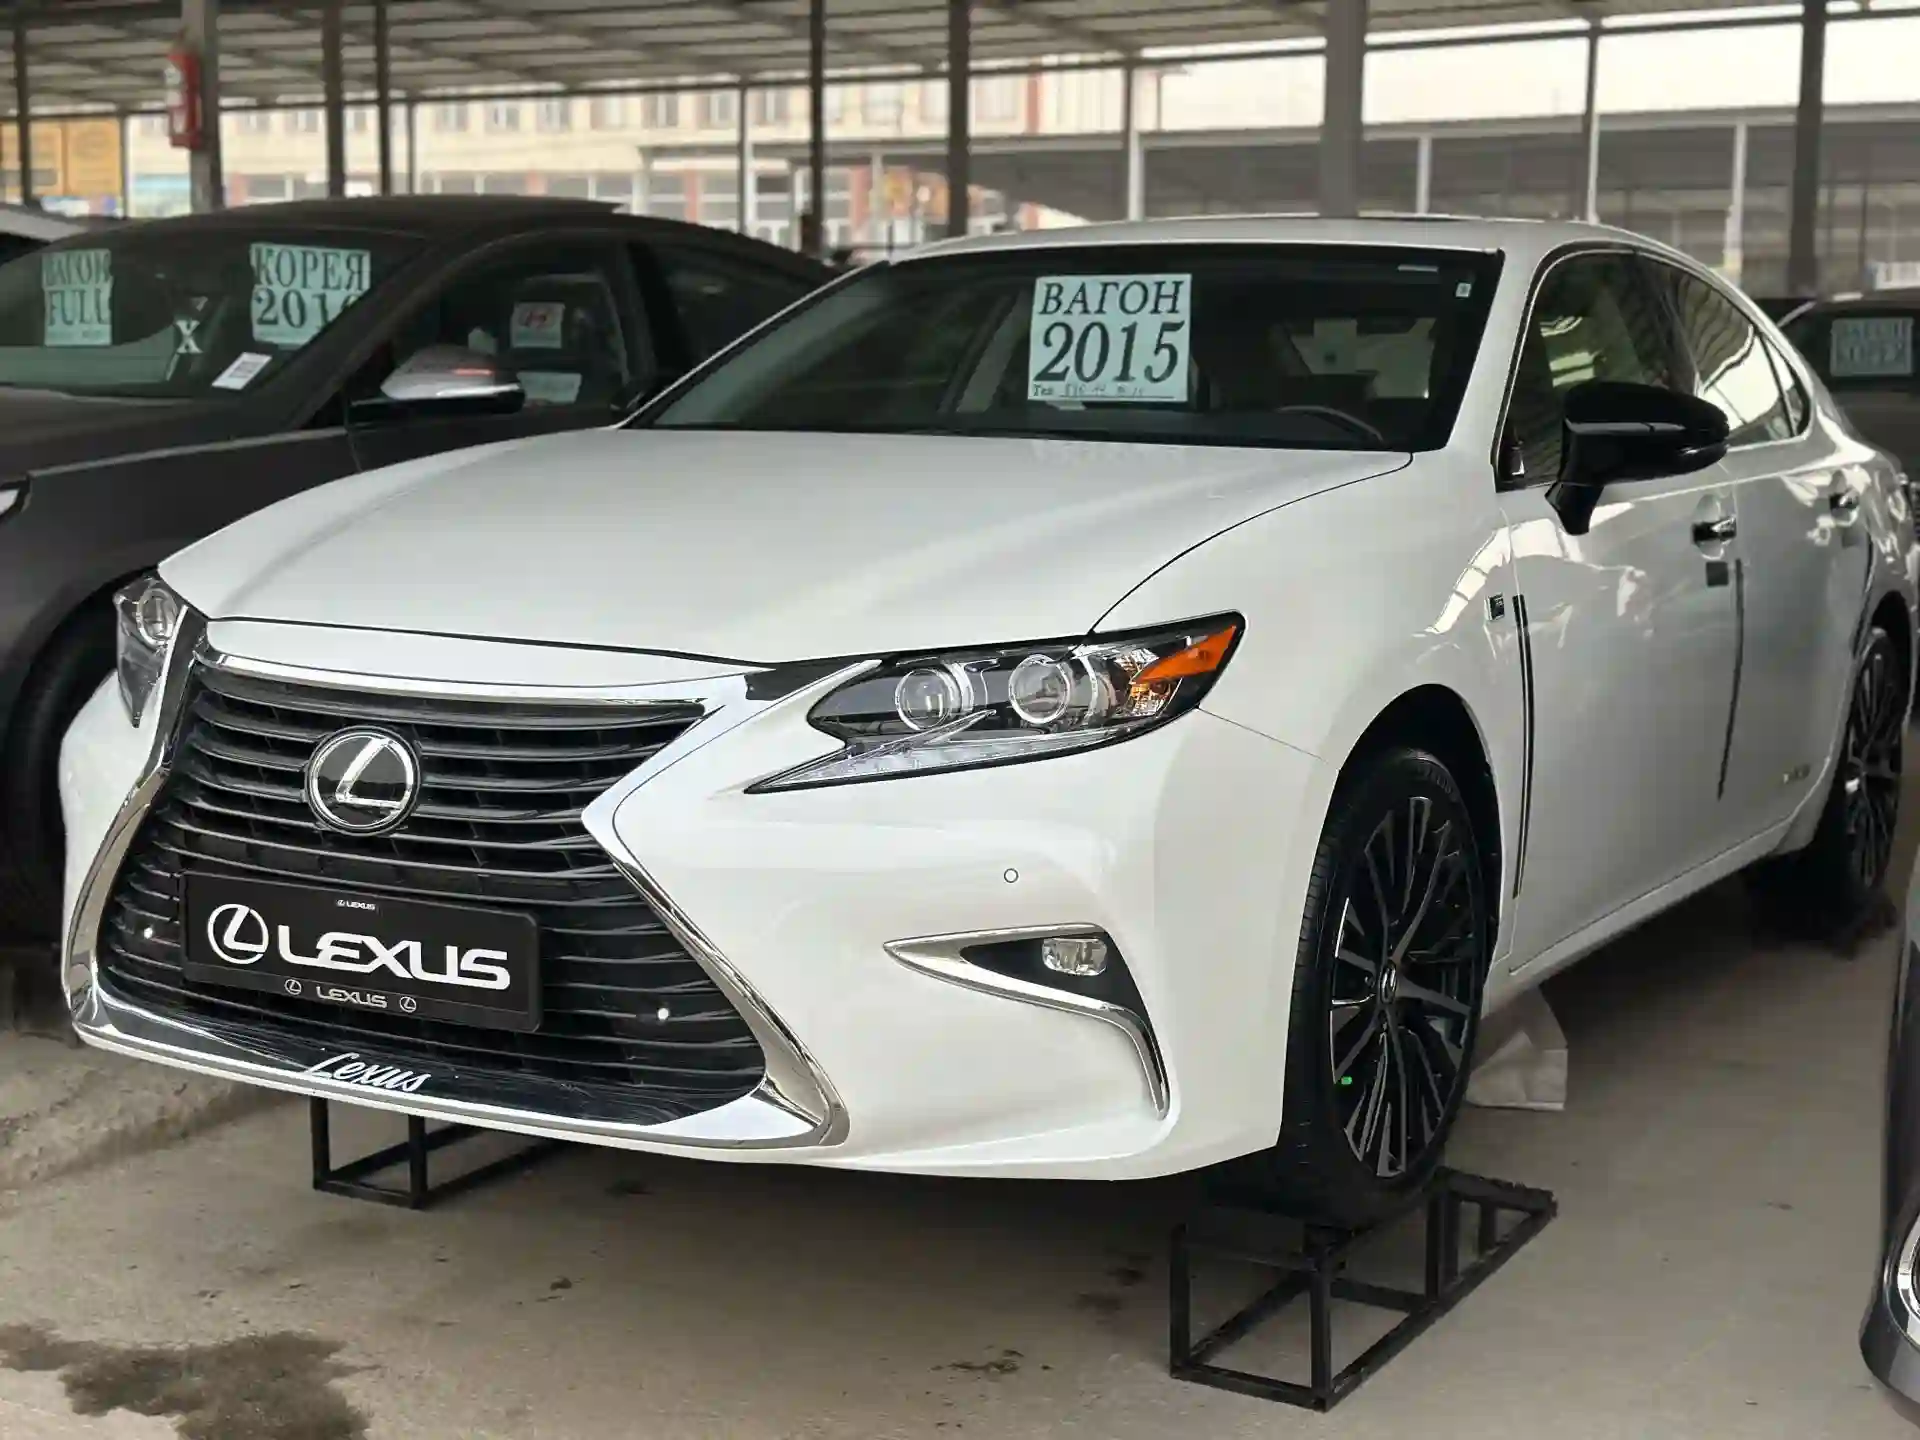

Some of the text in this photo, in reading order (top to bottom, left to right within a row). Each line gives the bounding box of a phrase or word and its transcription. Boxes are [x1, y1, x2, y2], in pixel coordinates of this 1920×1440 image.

[253, 246, 365, 291] КОРЕЯ
[47, 288, 110, 327] FULL
[1039, 280, 1184, 315] ВАГОН
[1032, 320, 1185, 384] 2015
[346, 900, 376, 911] LEXUS
[277, 924, 511, 991] LEXUS
[315, 986, 388, 1009] LEXUS
[304, 1052, 432, 1092] Lexus
